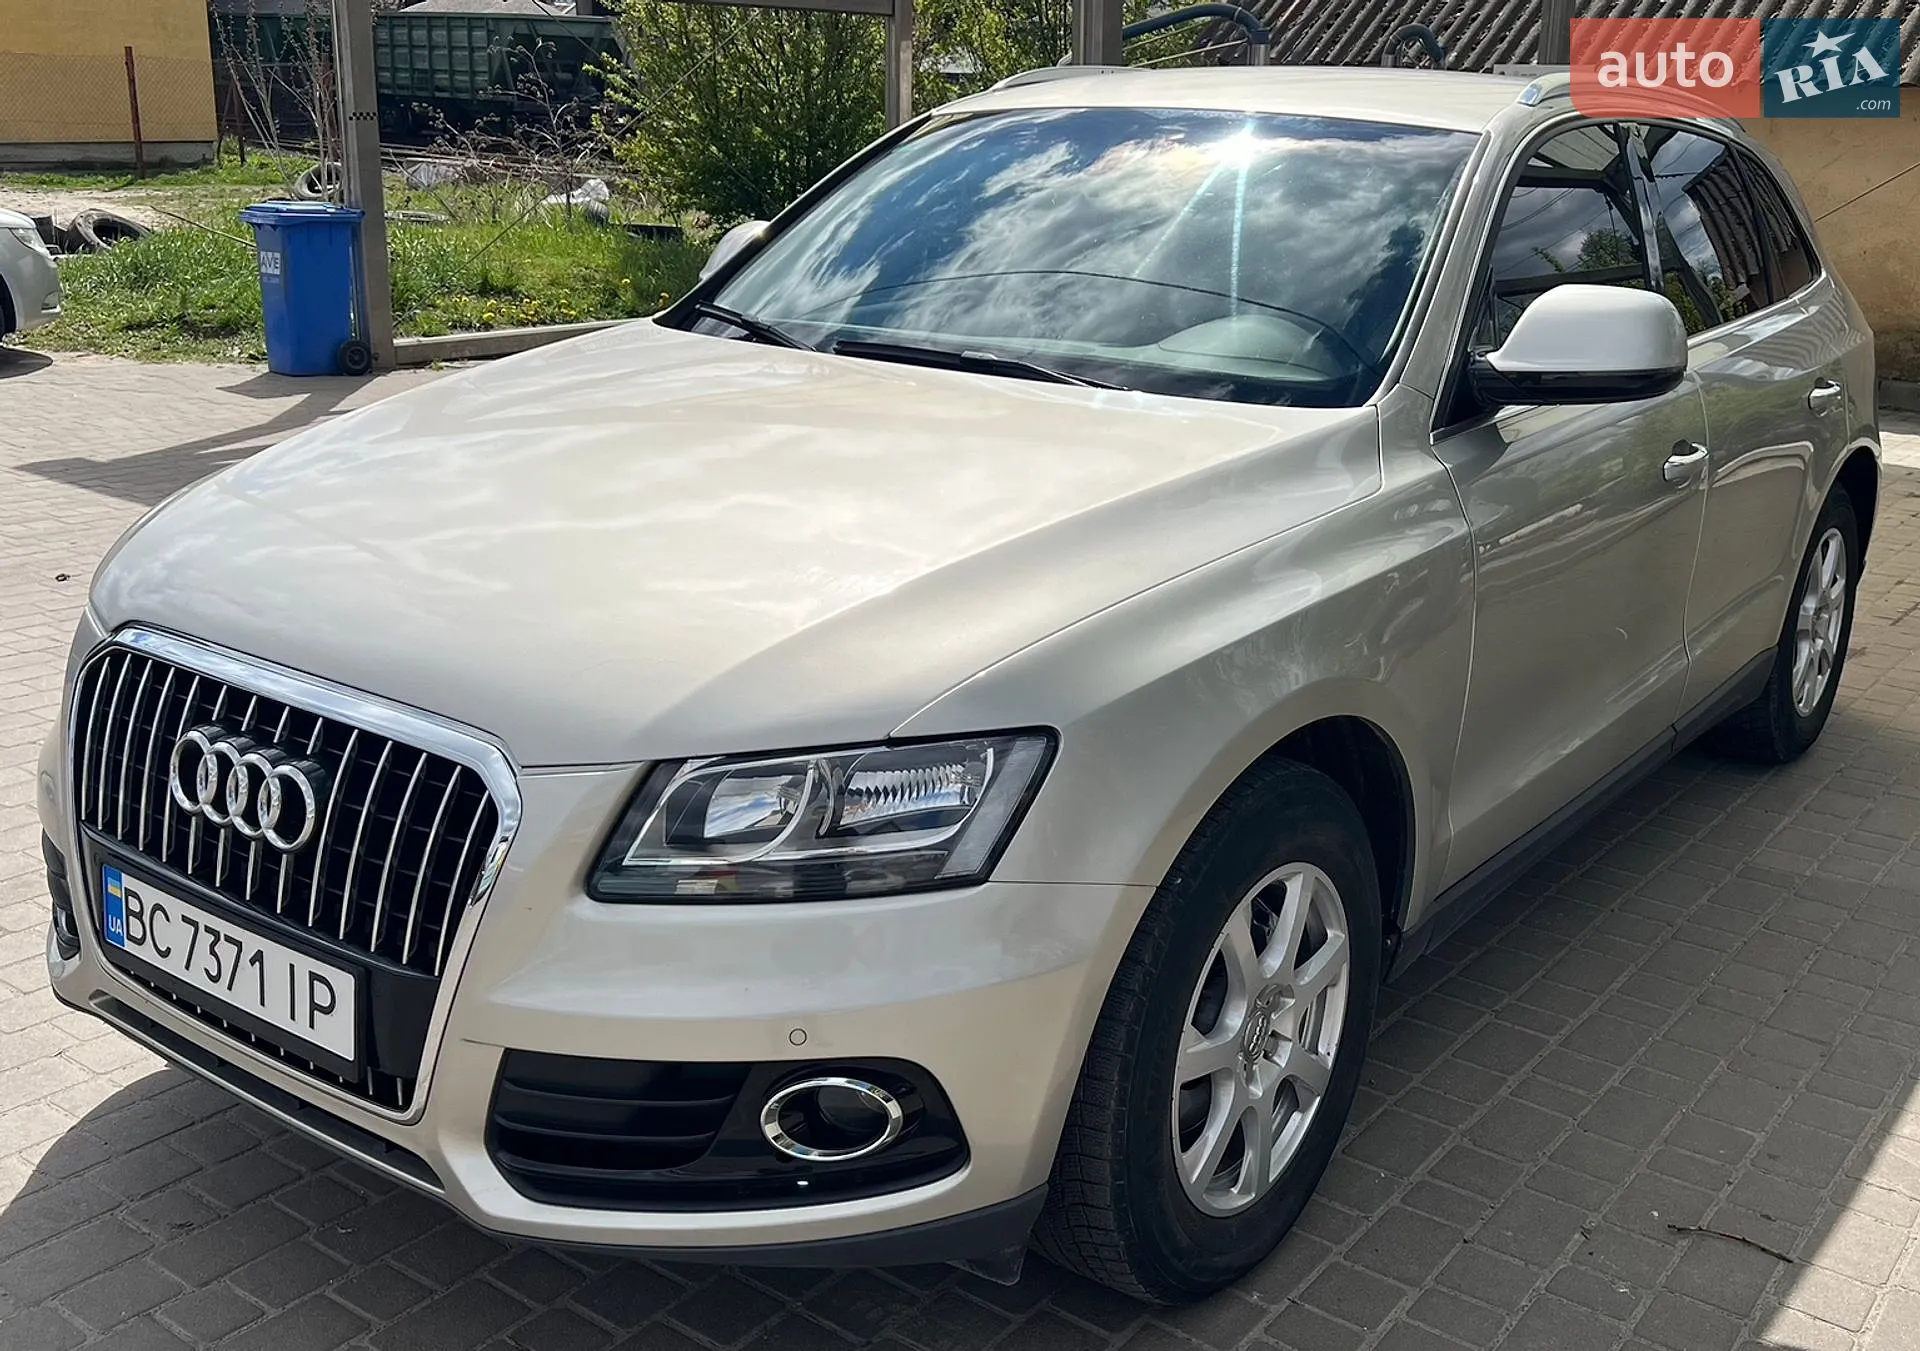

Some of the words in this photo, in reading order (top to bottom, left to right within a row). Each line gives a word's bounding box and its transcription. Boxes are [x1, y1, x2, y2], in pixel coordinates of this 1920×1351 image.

[261, 253, 280, 270] AVE
[108, 913, 123, 936] UA
[124, 887, 172, 958] BC
[181, 914, 265, 1007] 7371
[289, 963, 336, 1029] IP
